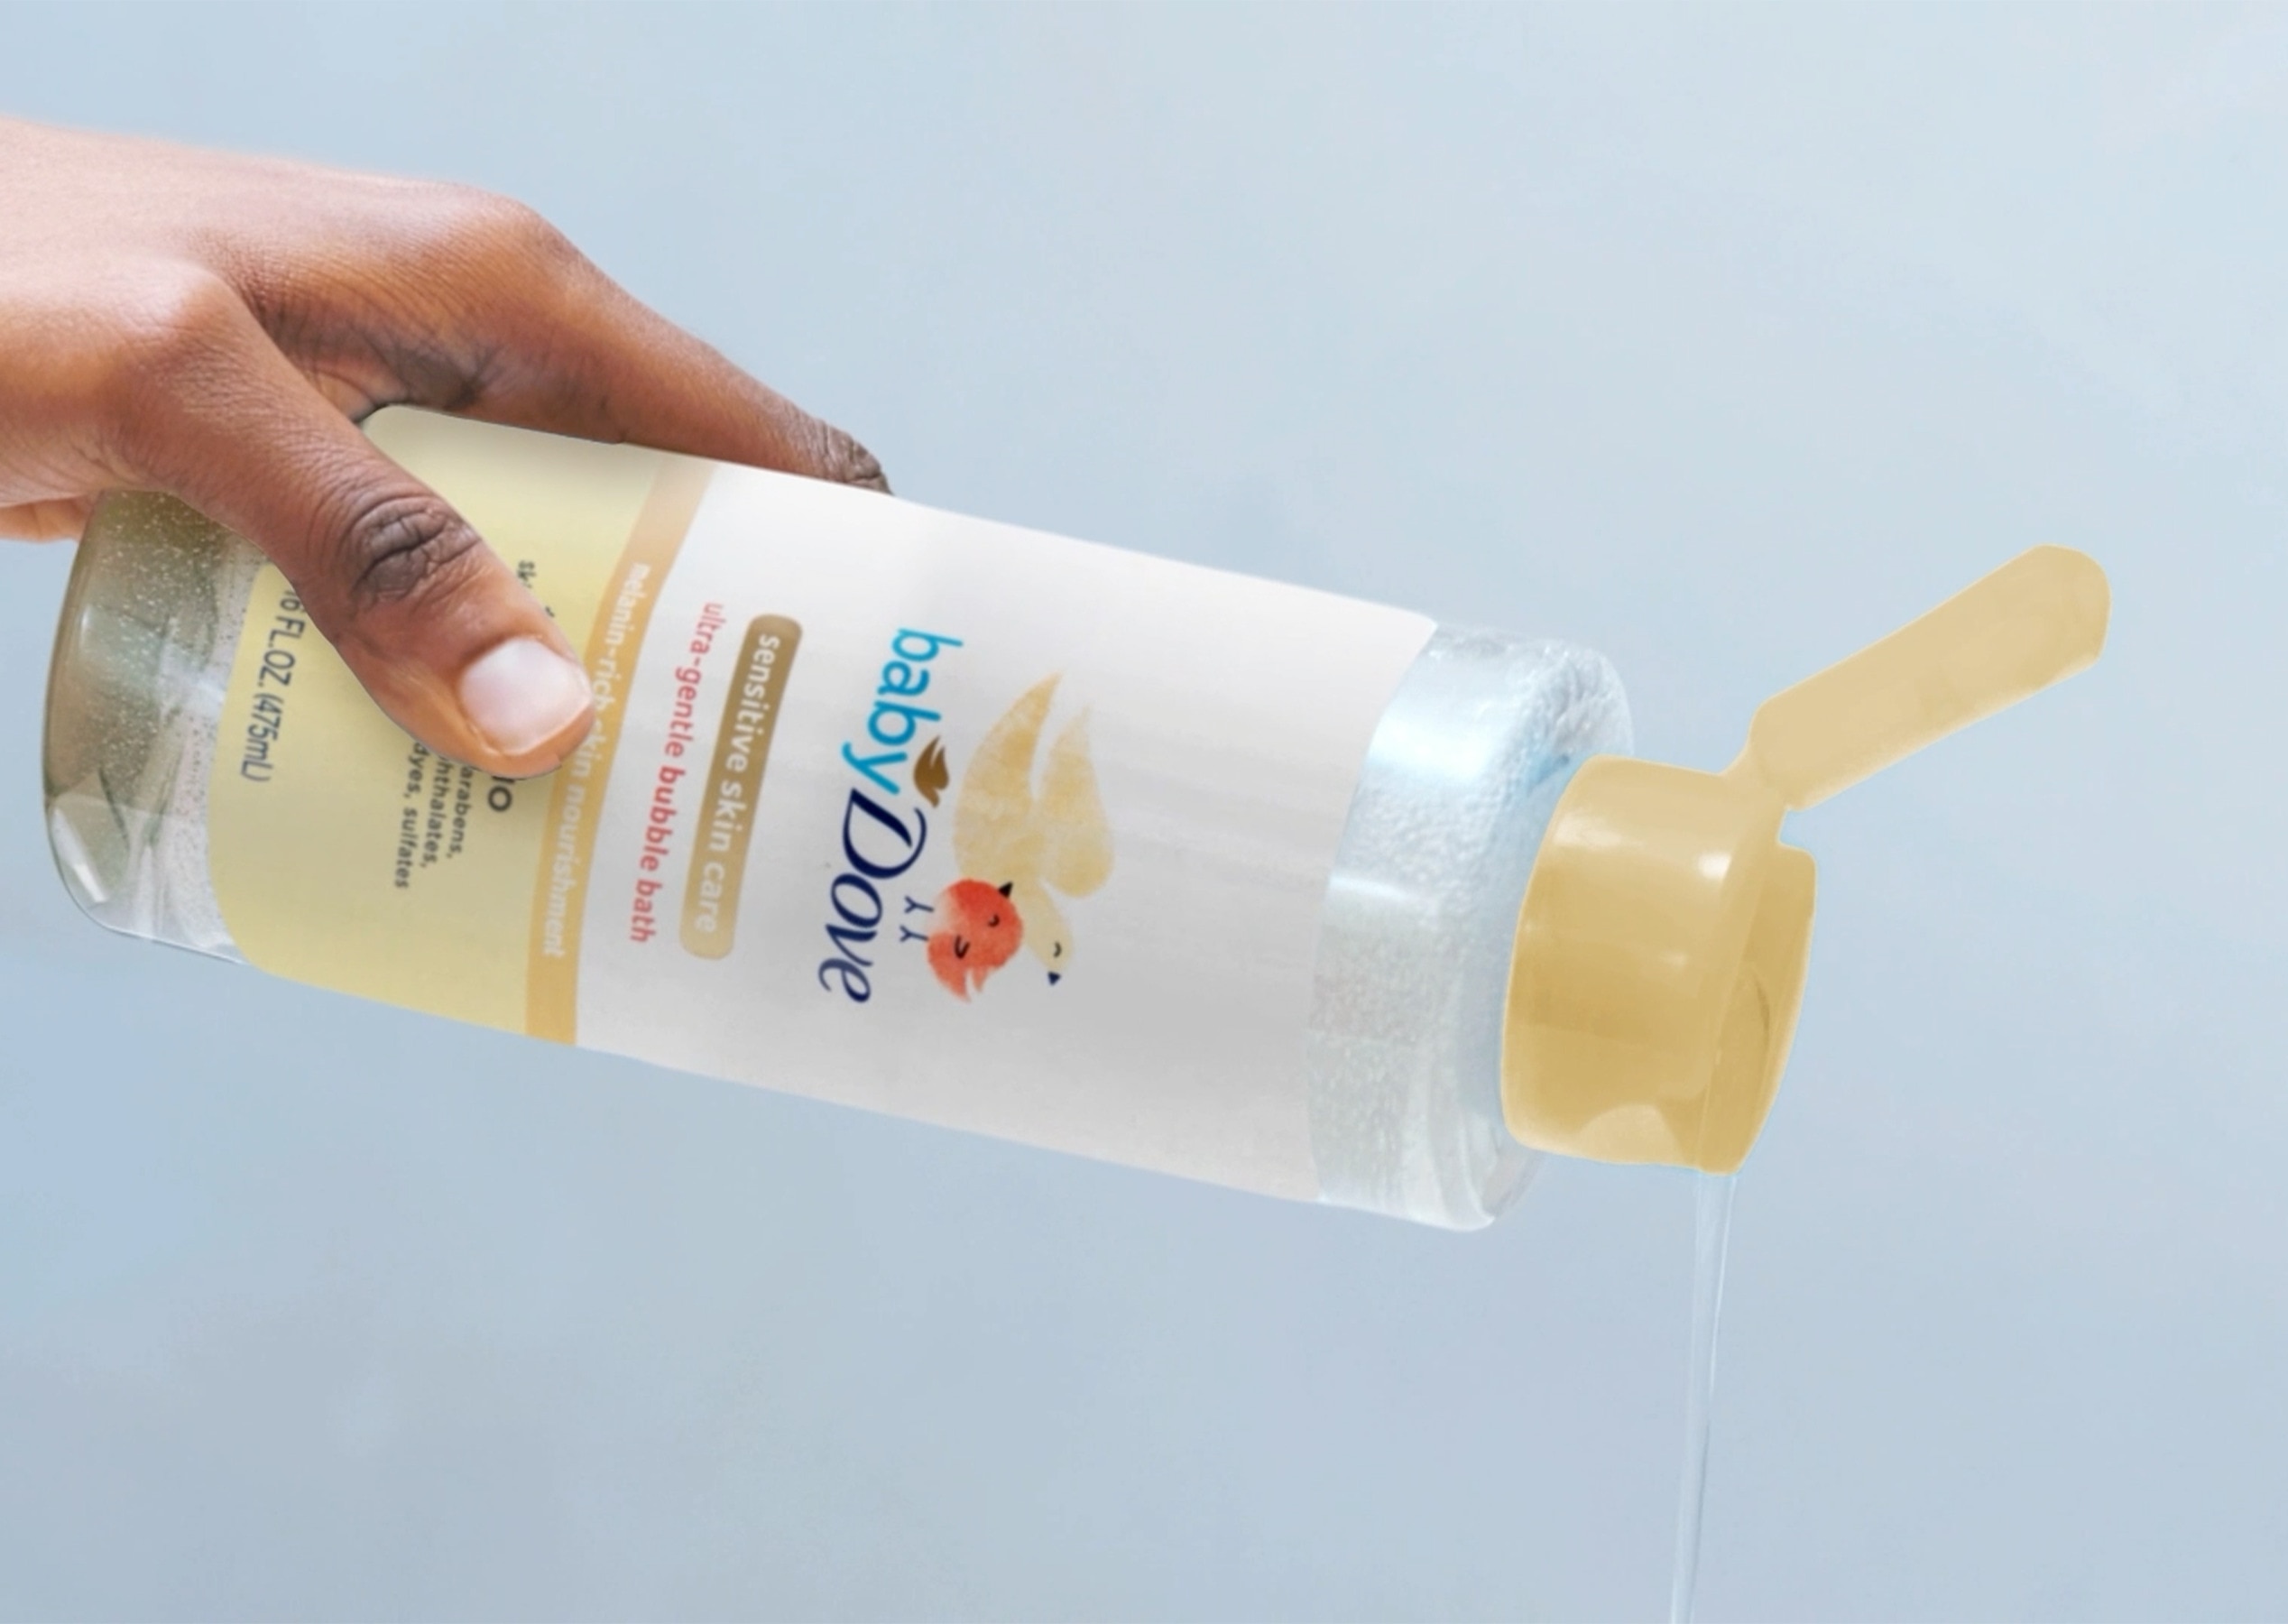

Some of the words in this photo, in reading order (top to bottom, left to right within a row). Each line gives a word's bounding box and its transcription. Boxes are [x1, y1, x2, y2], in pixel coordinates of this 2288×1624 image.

[592, 562, 651, 712] melanin-rich
[663, 602, 726, 758] ultra-gentle
[240, 692, 285, 783] (475mL)
[724, 633, 781, 773] sensitive
[841, 628, 964, 795] baby
[403, 743, 429, 798] dyes,
[420, 755, 453, 869] hthalates,
[446, 765, 475, 859] arabens,
[640, 765, 687, 872] bubble
[708, 780, 747, 853] skin
[394, 807, 418, 889] sulfates
[543, 783, 586, 958] nourishment
[695, 861, 725, 934] care
[818, 787, 928, 1003] Dove
[630, 879, 663, 943] bath
